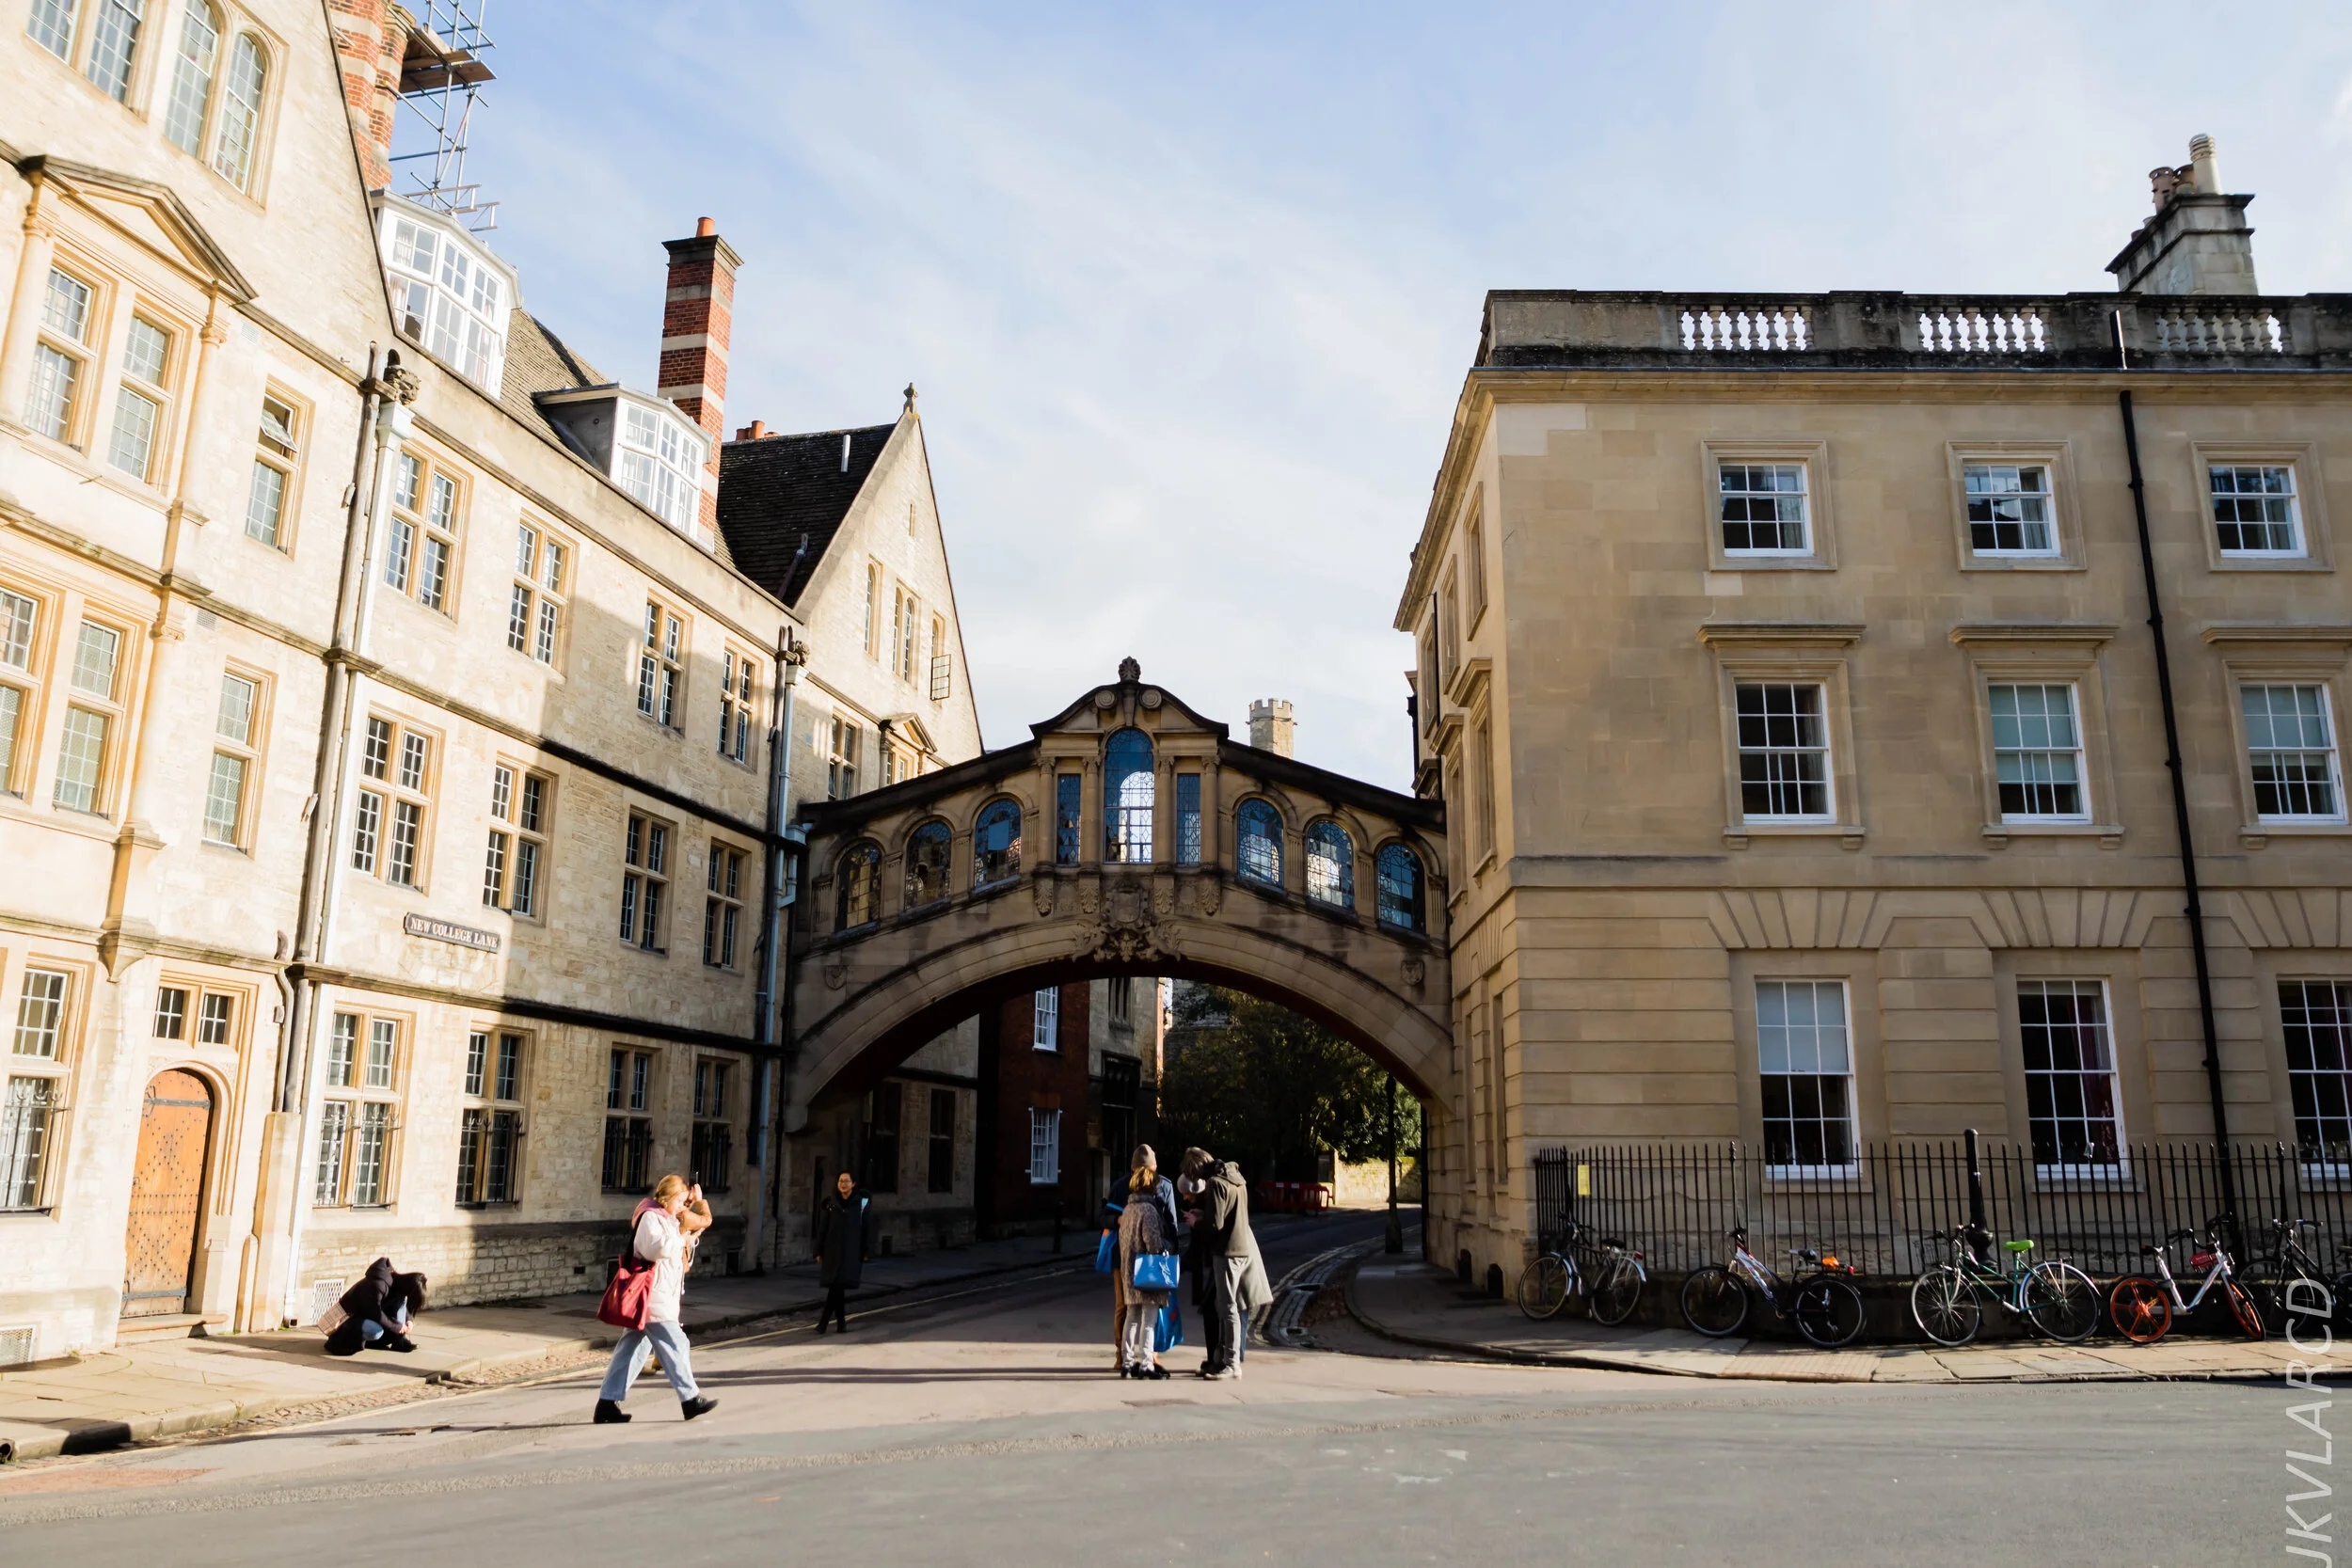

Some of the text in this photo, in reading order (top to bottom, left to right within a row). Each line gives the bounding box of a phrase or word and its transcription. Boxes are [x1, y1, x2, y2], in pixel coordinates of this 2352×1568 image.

[410, 917, 498, 948] NEW COLLEGE LANE
